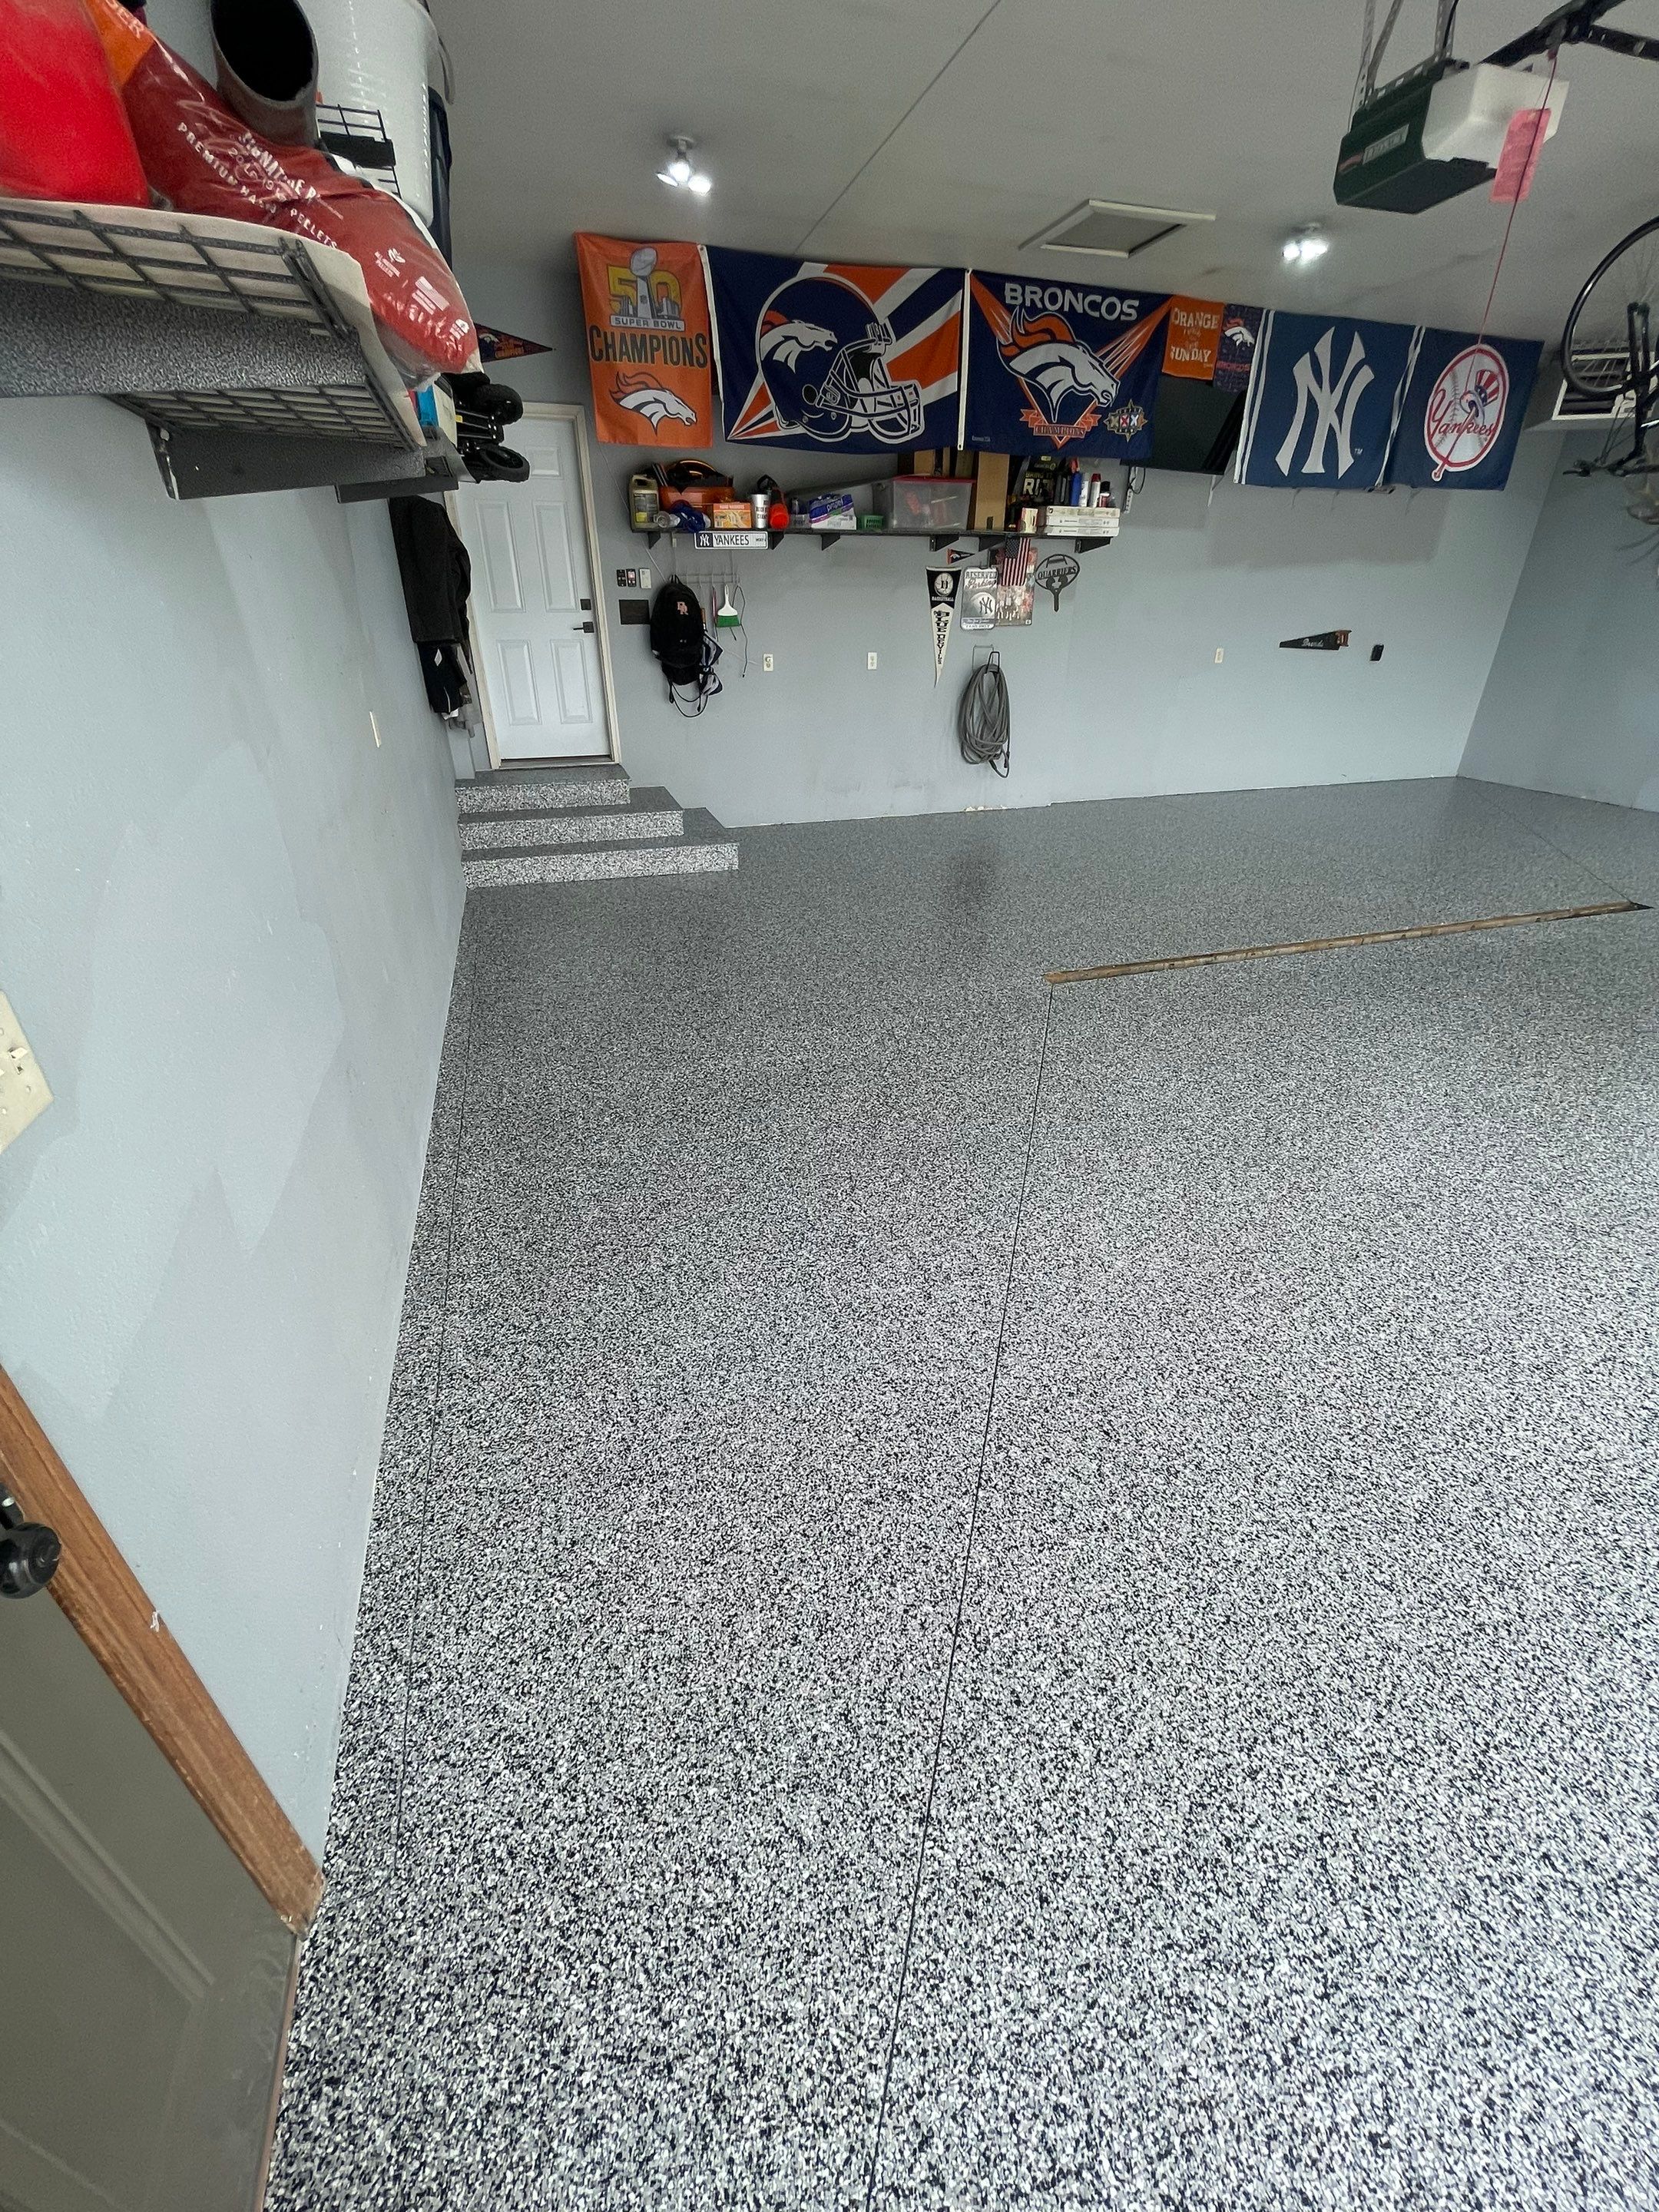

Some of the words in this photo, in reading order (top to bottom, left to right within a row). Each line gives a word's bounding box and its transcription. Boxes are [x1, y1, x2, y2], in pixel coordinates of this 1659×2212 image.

[177, 122, 238, 186] PREMIUM
[290, 208, 336, 249] PELLETS
[1005, 283, 1139, 321] BRONCOS
[614, 316, 648, 327] SUPER
[653, 319, 681, 329] BOWL
[588, 325, 708, 369] CHAMPIONS
[714, 535, 750, 545] YANKEES
[965, 578, 996, 590] Parking
[937, 634, 946, 665] DEVILS
